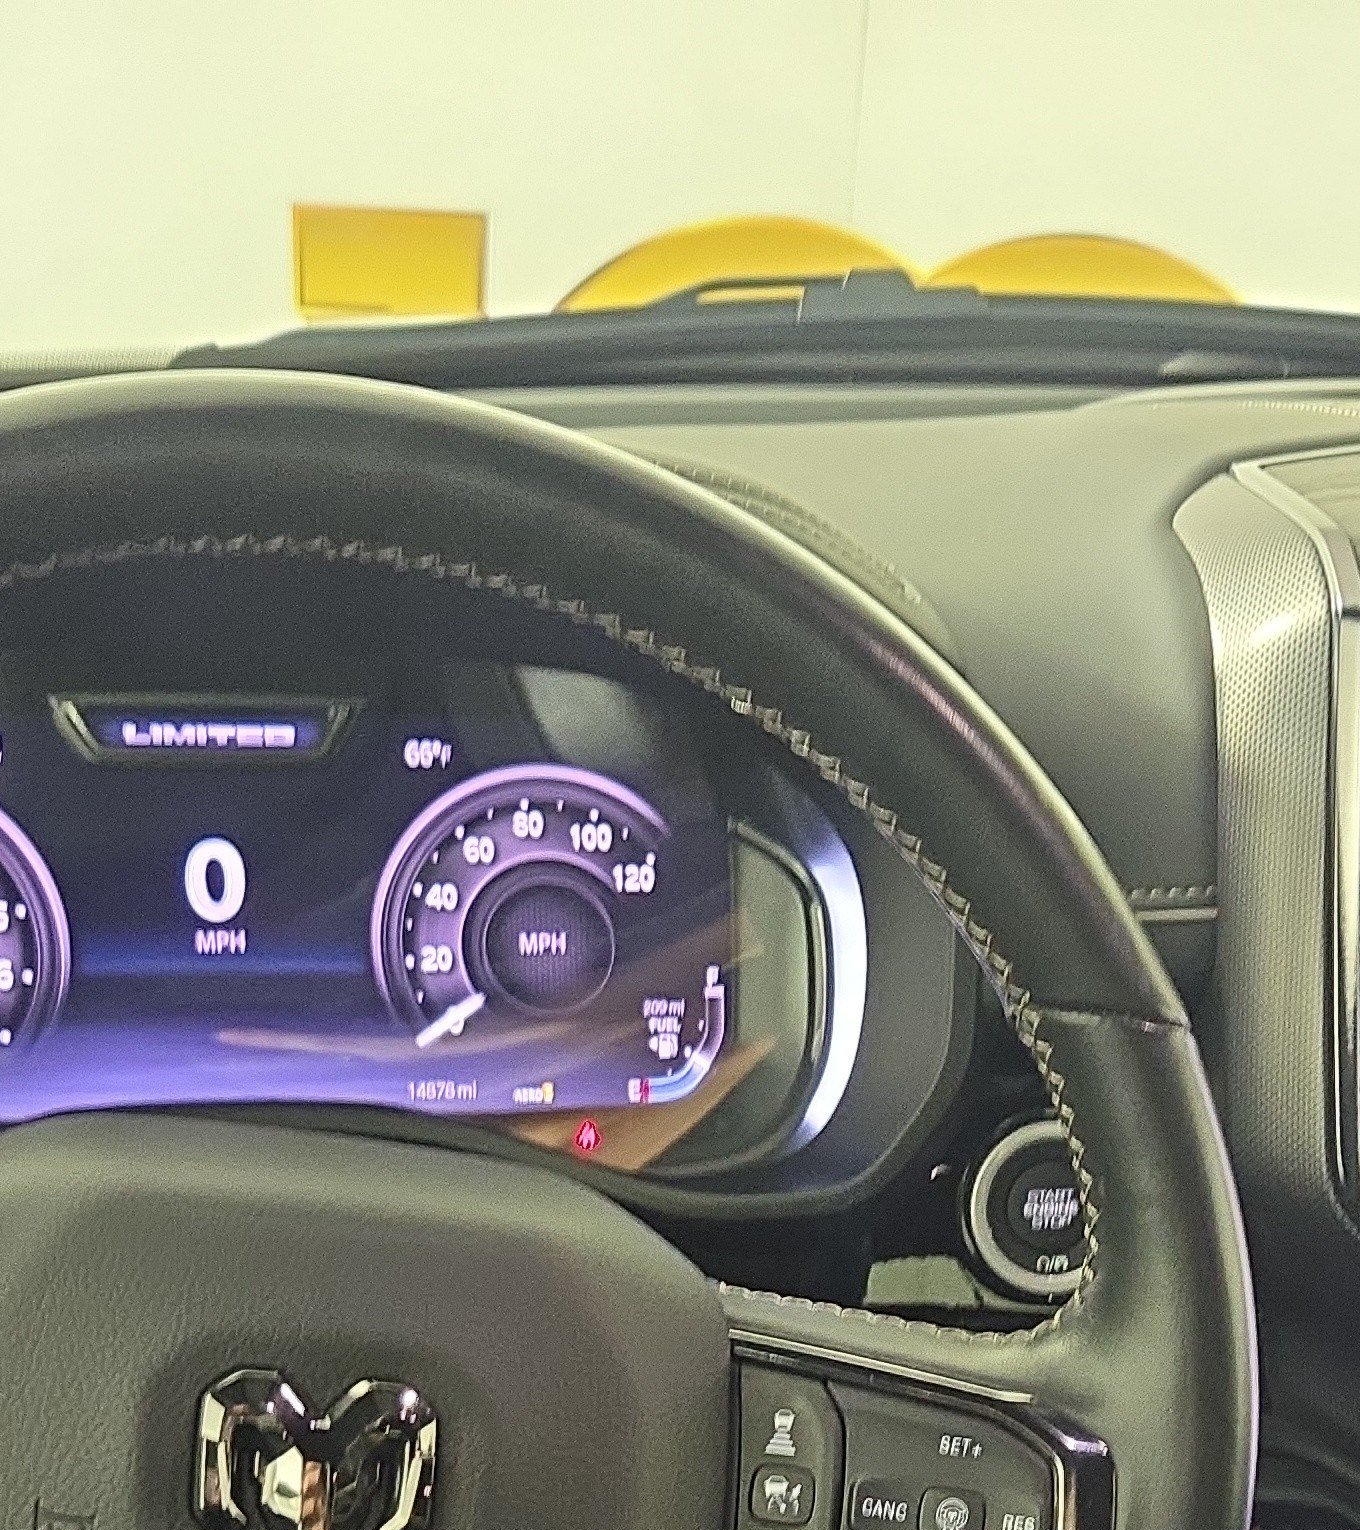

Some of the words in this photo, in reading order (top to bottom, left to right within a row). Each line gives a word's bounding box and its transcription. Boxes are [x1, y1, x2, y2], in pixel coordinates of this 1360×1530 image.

[122, 721, 297, 748] LIMITED
[512, 810, 544, 838] 80
[570, 823, 612, 852] 100
[463, 836, 495, 864] 60
[185, 837, 246, 923] 0
[612, 864, 655, 893] 120
[424, 883, 458, 911] 40
[195, 928, 246, 954] MPH
[519, 932, 567, 956] MPH
[421, 945, 454, 974] 20
